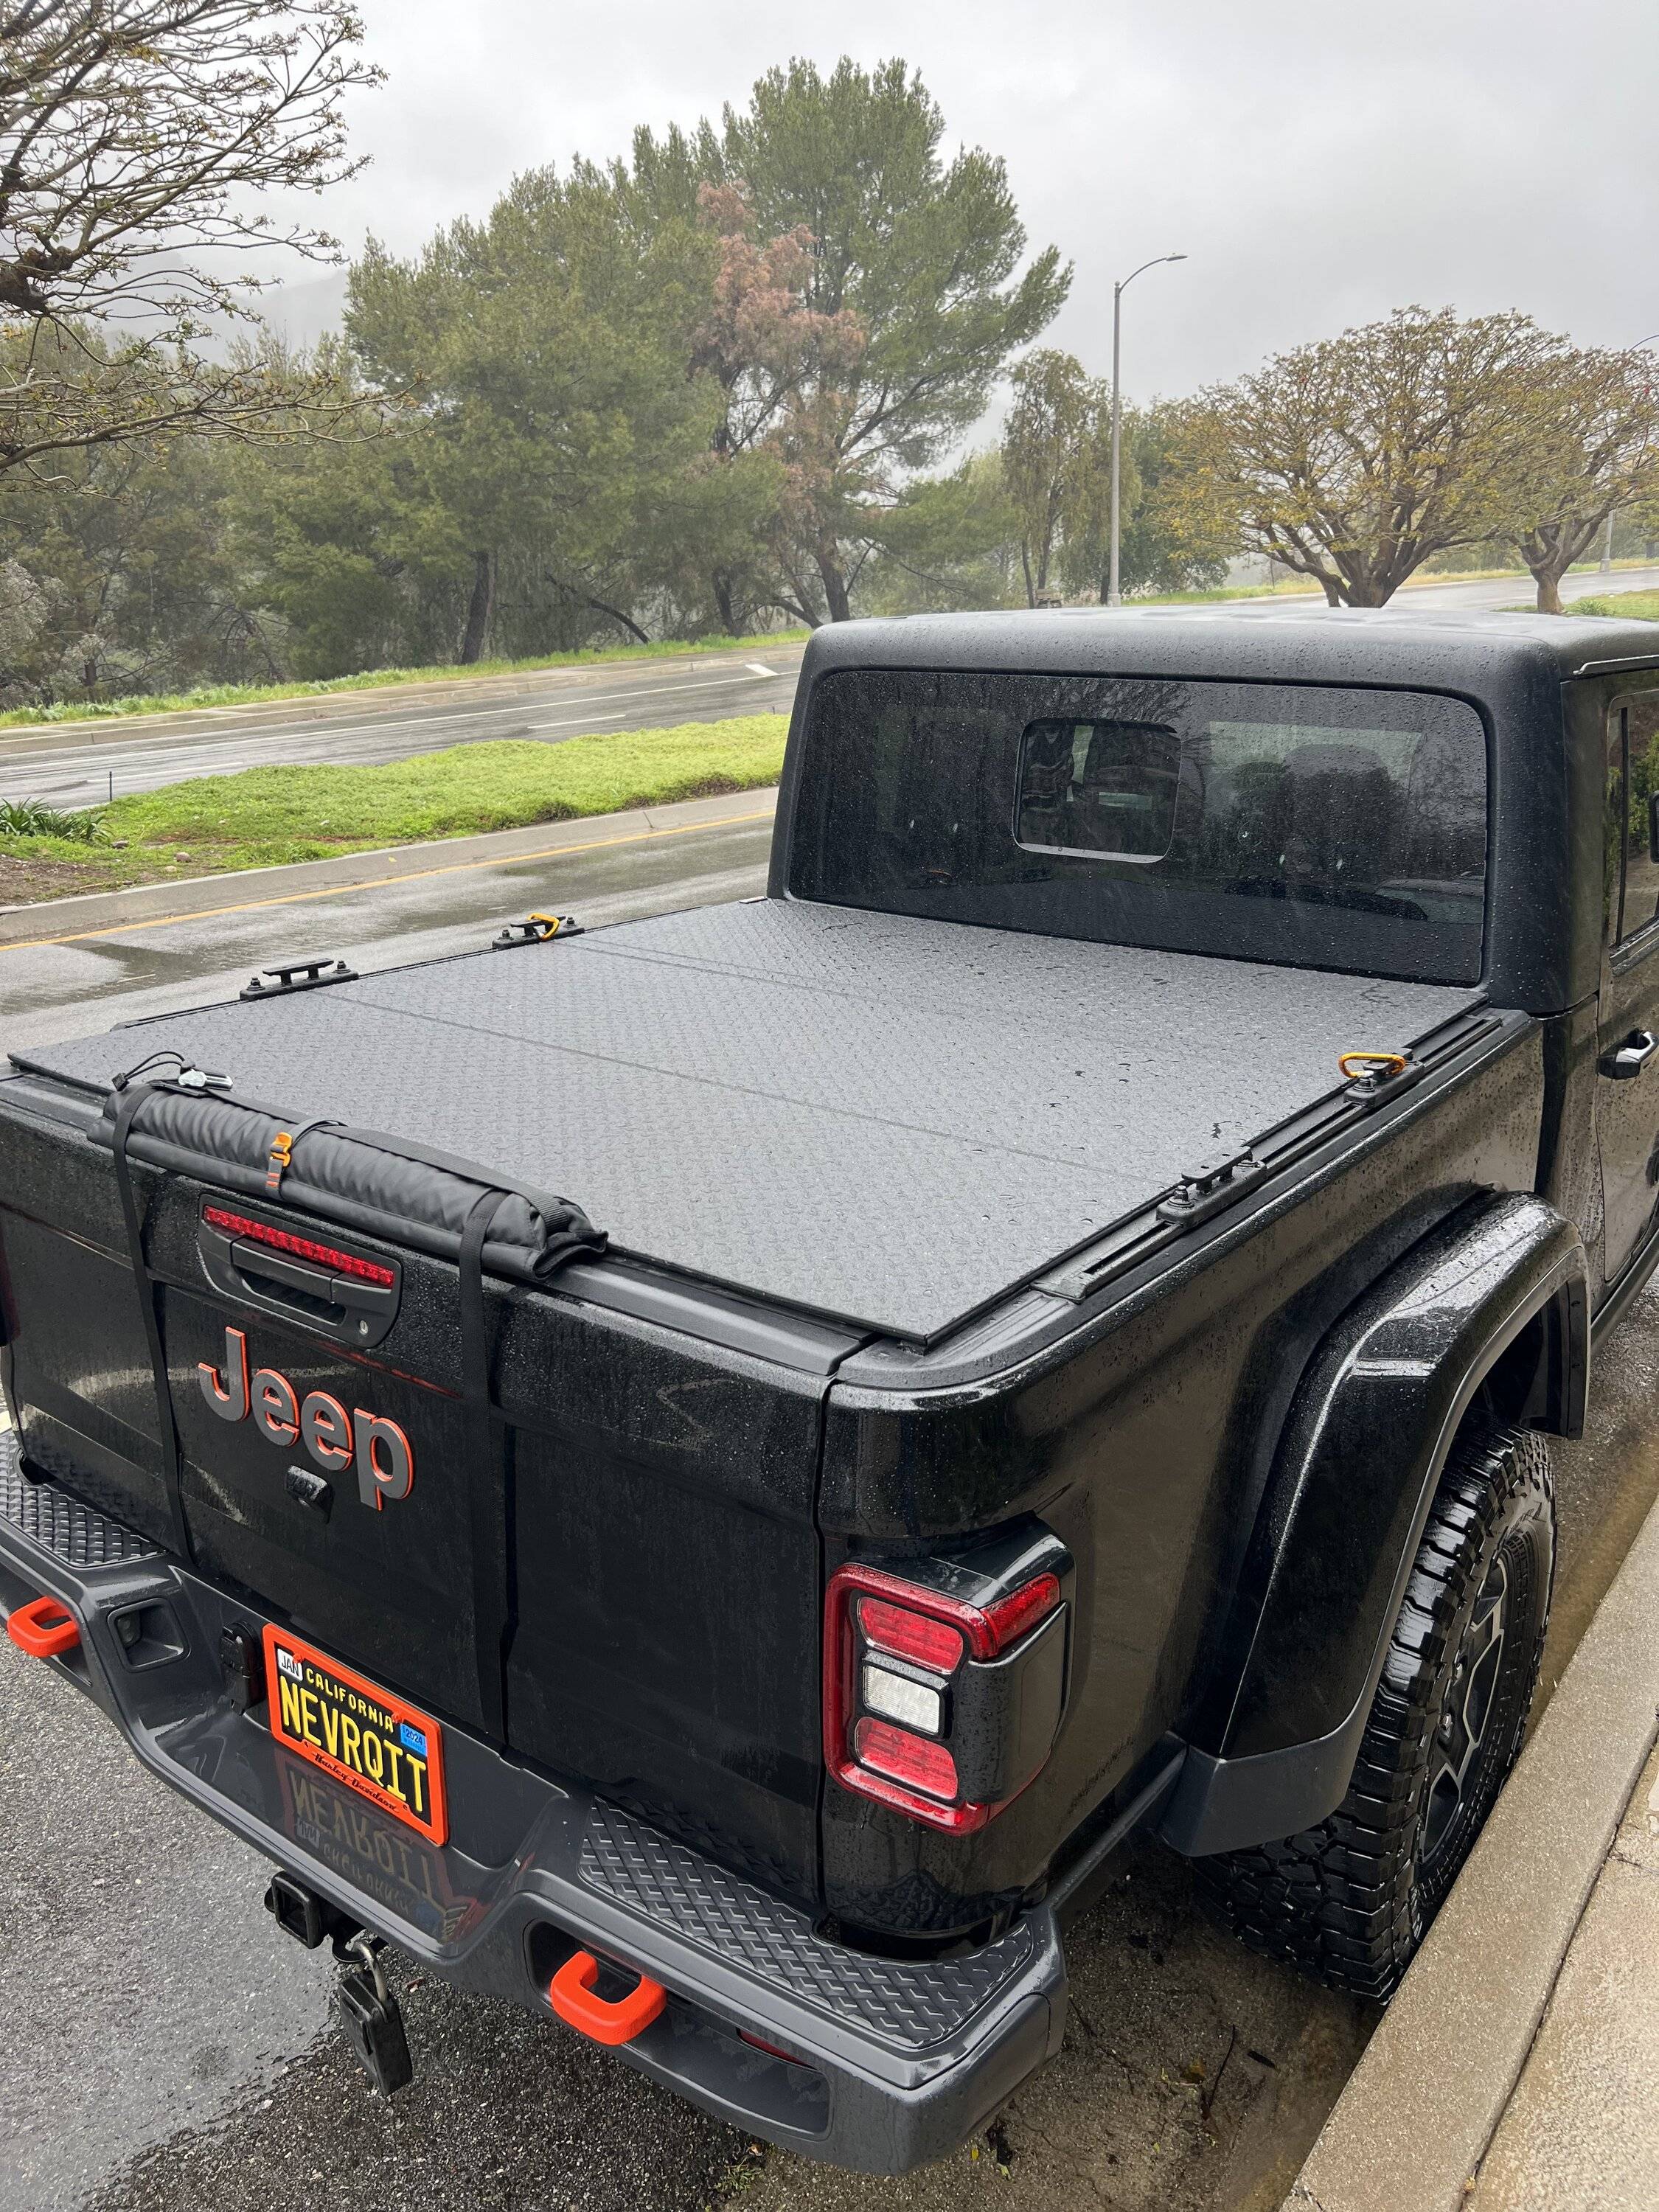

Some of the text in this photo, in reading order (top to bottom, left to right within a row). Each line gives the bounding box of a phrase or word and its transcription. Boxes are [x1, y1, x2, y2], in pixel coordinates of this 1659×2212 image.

[198, 1326, 414, 1512] Jeep
[281, 1655, 300, 1677] JAN
[306, 1667, 394, 1733] CALIFORNIA
[279, 1674, 427, 1812] NEVRQIT
[406, 1728, 423, 1746] 2024
